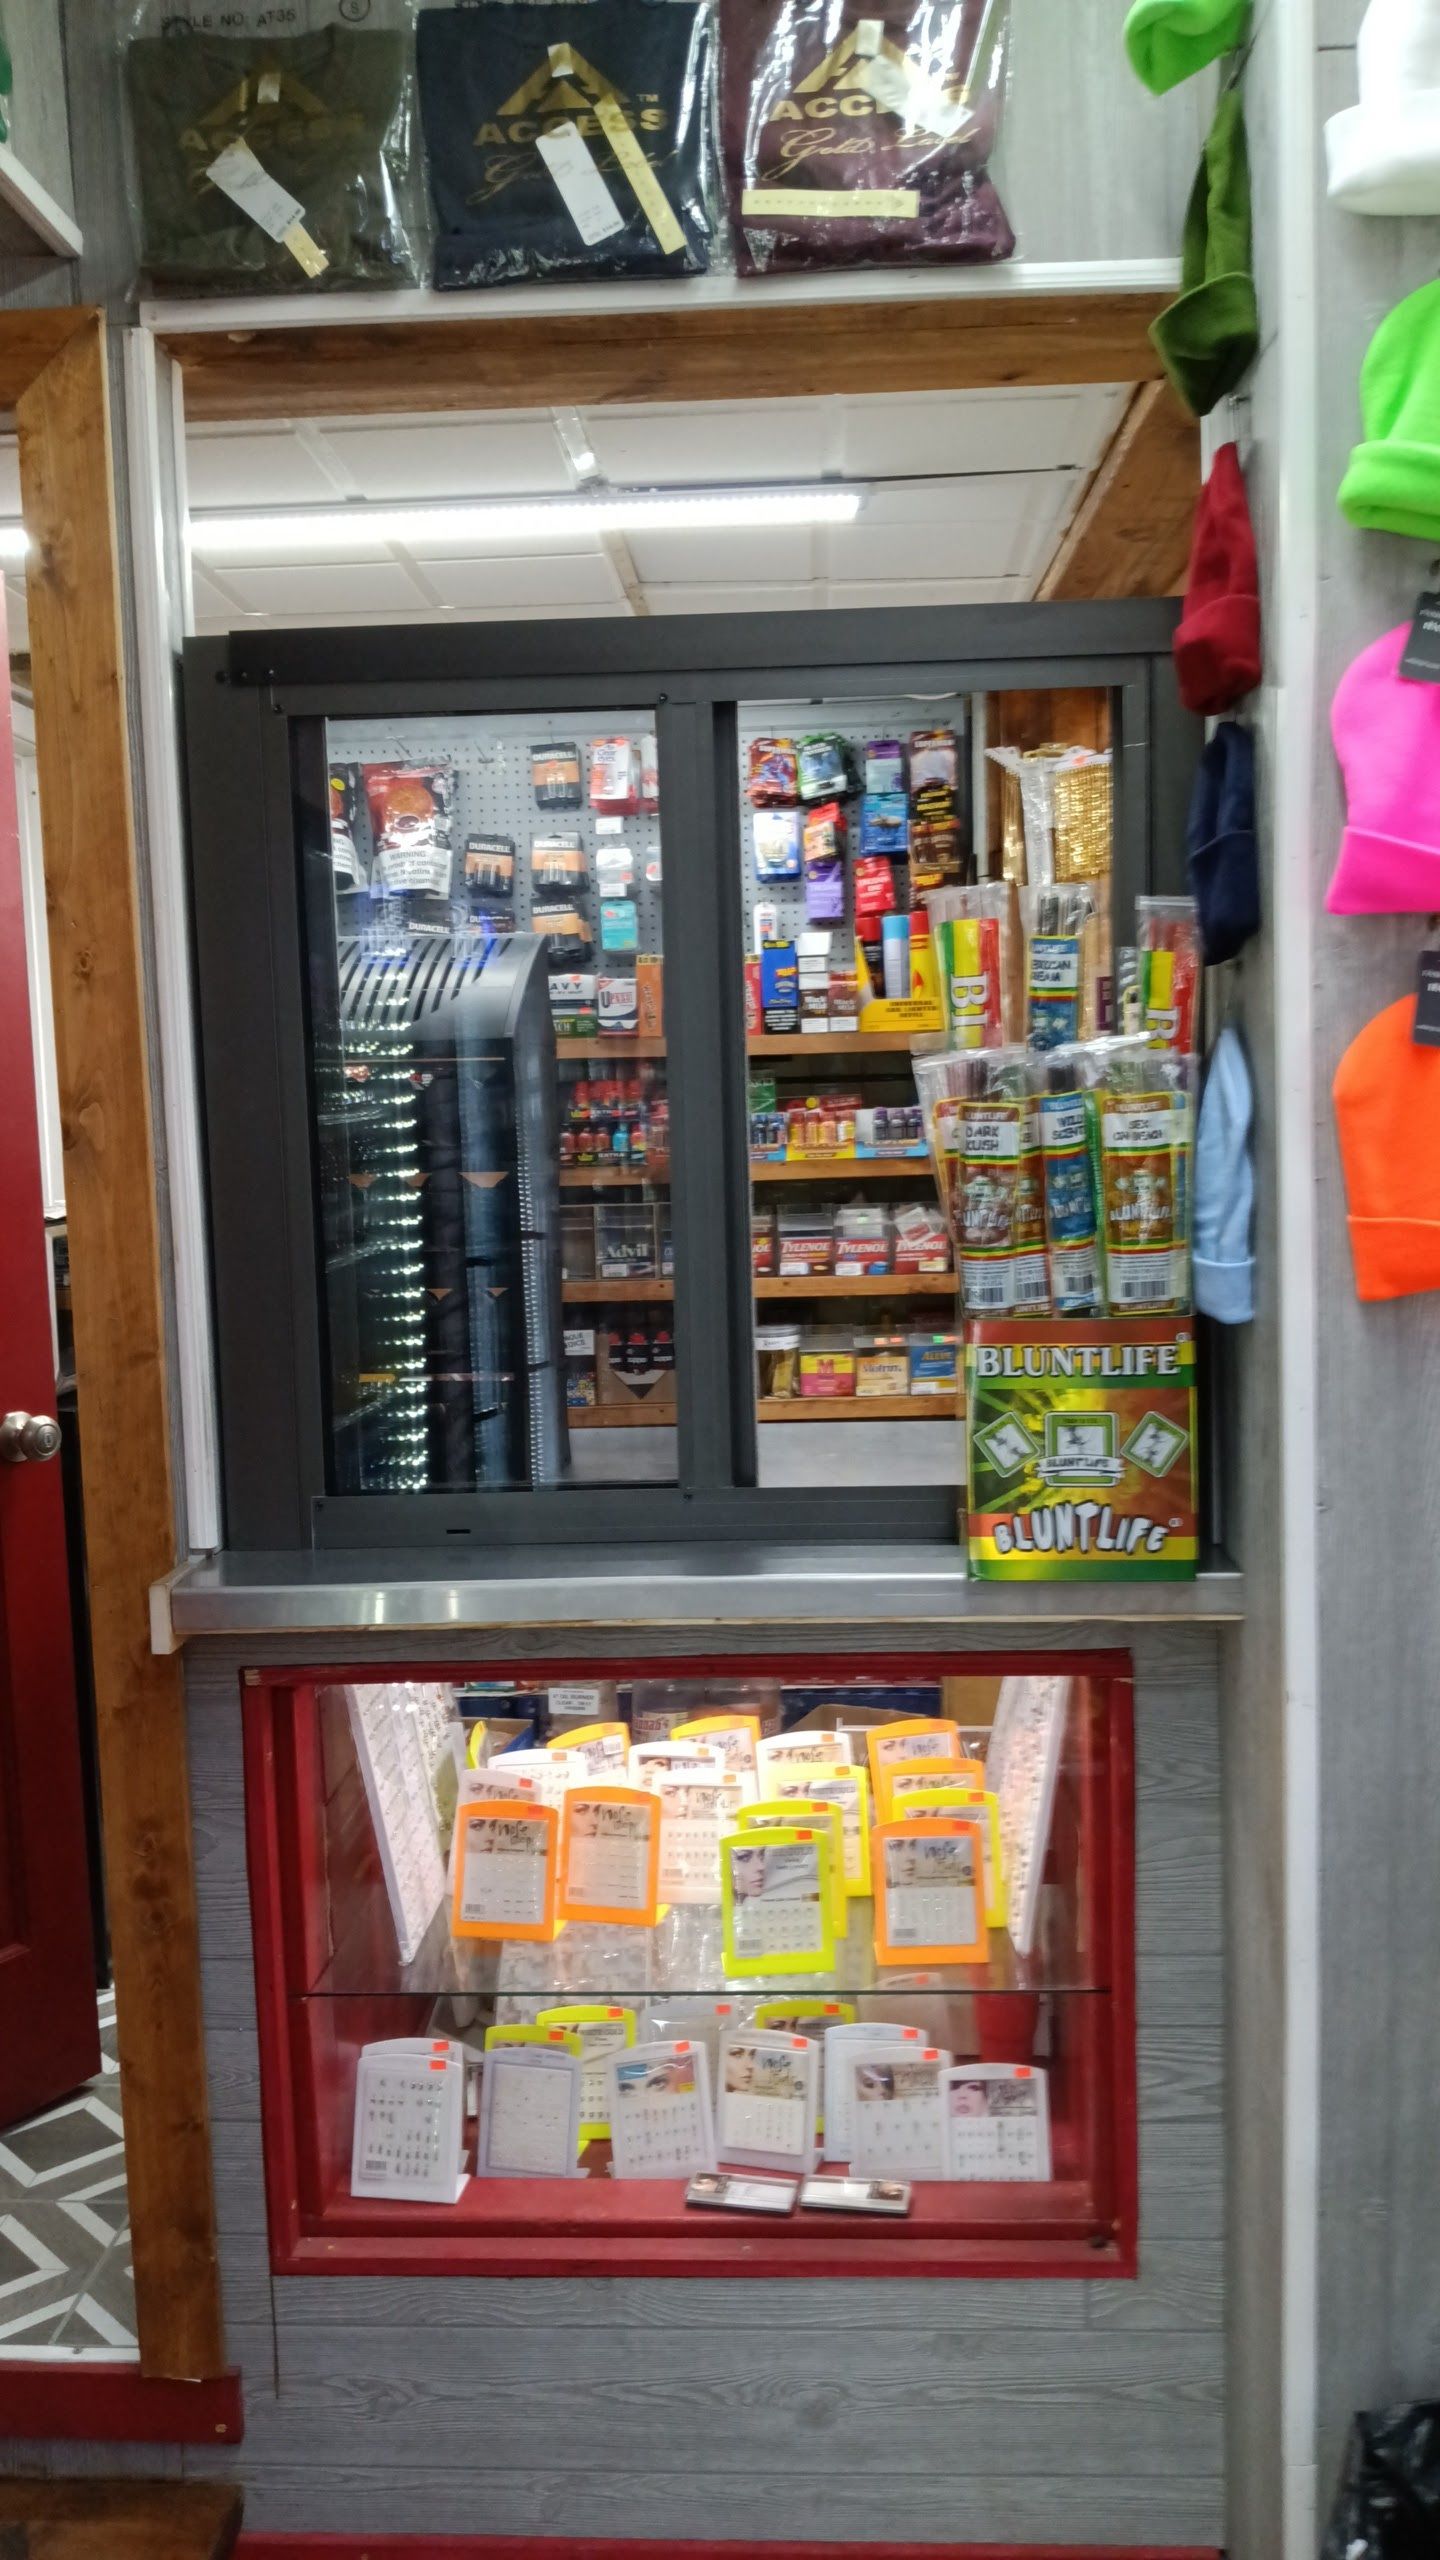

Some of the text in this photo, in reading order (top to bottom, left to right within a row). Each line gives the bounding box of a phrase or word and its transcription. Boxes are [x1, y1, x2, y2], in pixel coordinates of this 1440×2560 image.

[532, 751, 577, 761] DURACELL
[468, 842, 511, 852] DURACELL
[534, 840, 577, 849] DURACELL
[533, 904, 575, 914] DURACELL
[965, 1125, 1000, 1138] DARK
[965, 1139, 1000, 1151] KUSH
[606, 1243, 649, 1258] Advil
[781, 1241, 831, 1253] TYLENOL
[837, 1242, 888, 1254] TYLENOL
[976, 1344, 1182, 1378] BLUNTLIFE
[994, 1500, 1169, 1556] BLUNTLIFE
